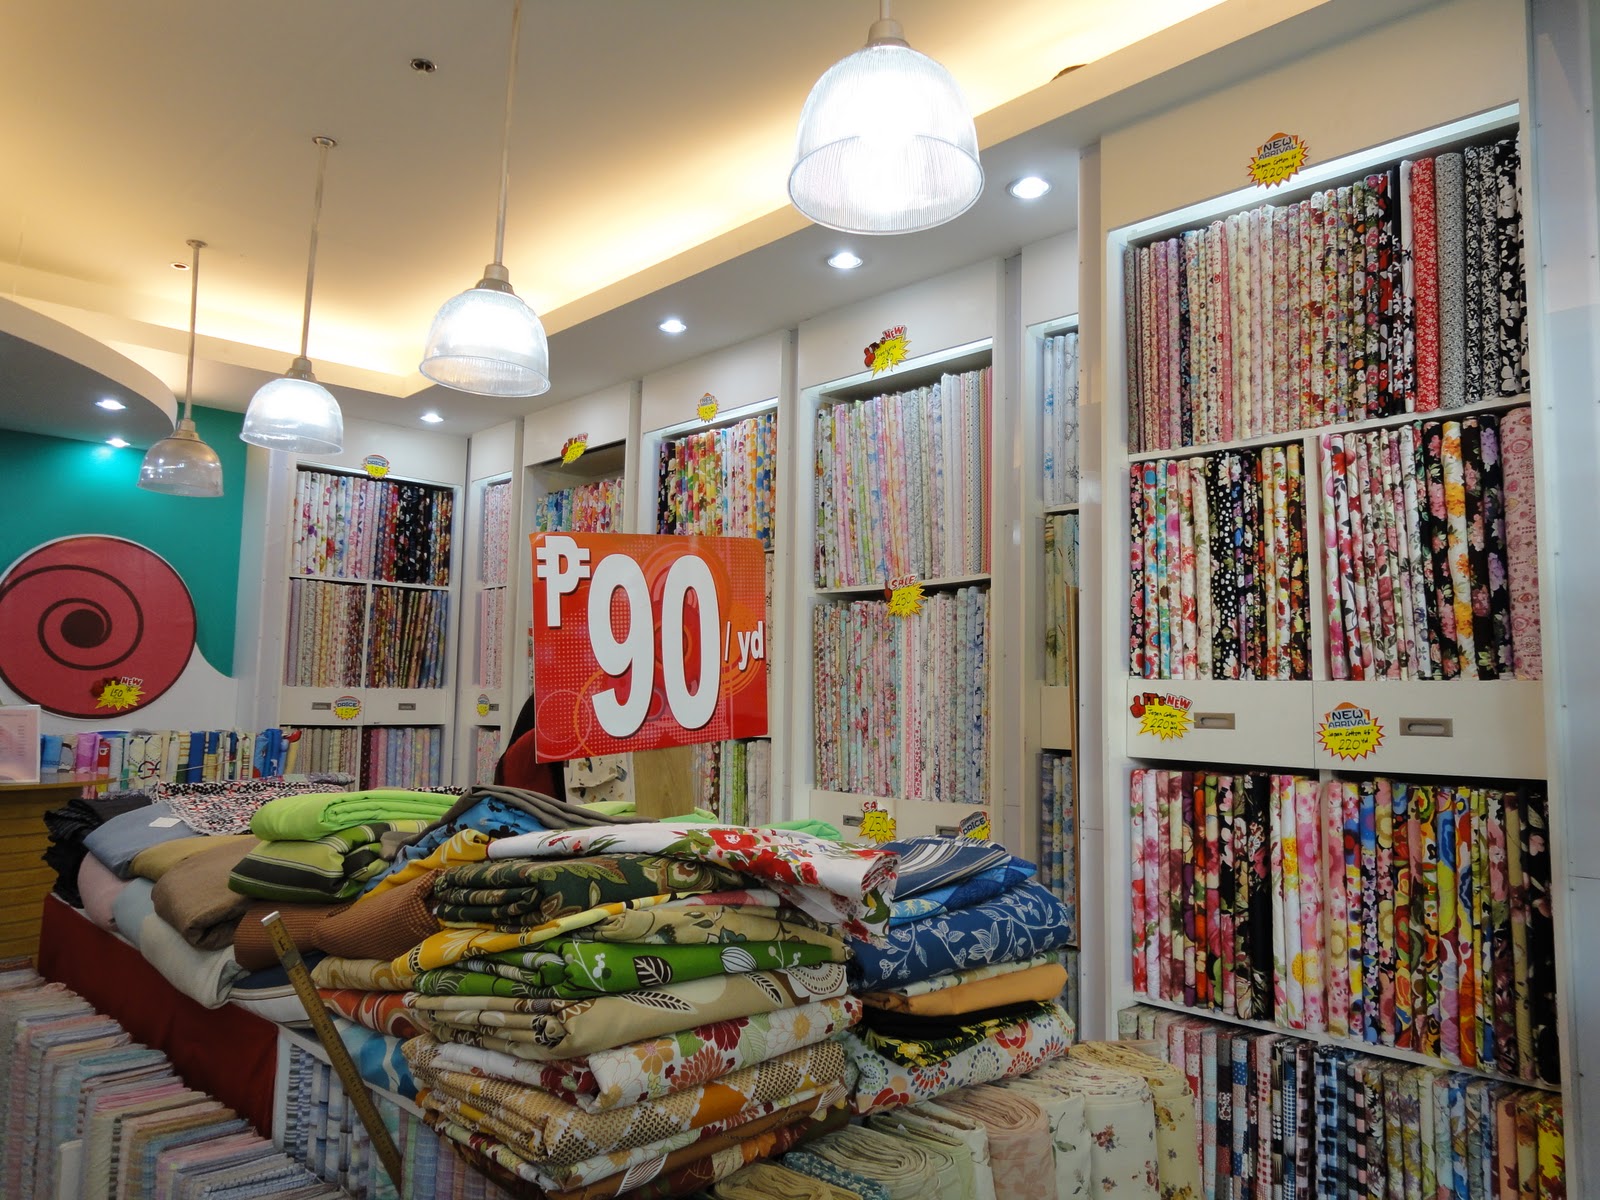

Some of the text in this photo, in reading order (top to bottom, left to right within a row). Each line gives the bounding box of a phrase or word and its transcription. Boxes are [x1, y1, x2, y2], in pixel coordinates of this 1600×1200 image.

[1258, 144, 1298, 160] ARRIVAL
[1263, 137, 1292, 153] NEW
[1262, 166, 1284, 180] 220
[883, 326, 905, 340] NEW
[891, 575, 916, 589] SALE
[895, 592, 912, 607] 250
[121, 676, 142, 687] NEW
[1167, 694, 1192, 710] NEW
[1332, 709, 1363, 721] NEW
[1149, 718, 1170, 730] 220
[1328, 718, 1371, 729] ARRIVAL
[1338, 738, 1361, 751] 220
[869, 816, 888, 834] 250
[962, 817, 986, 836] PRICE
